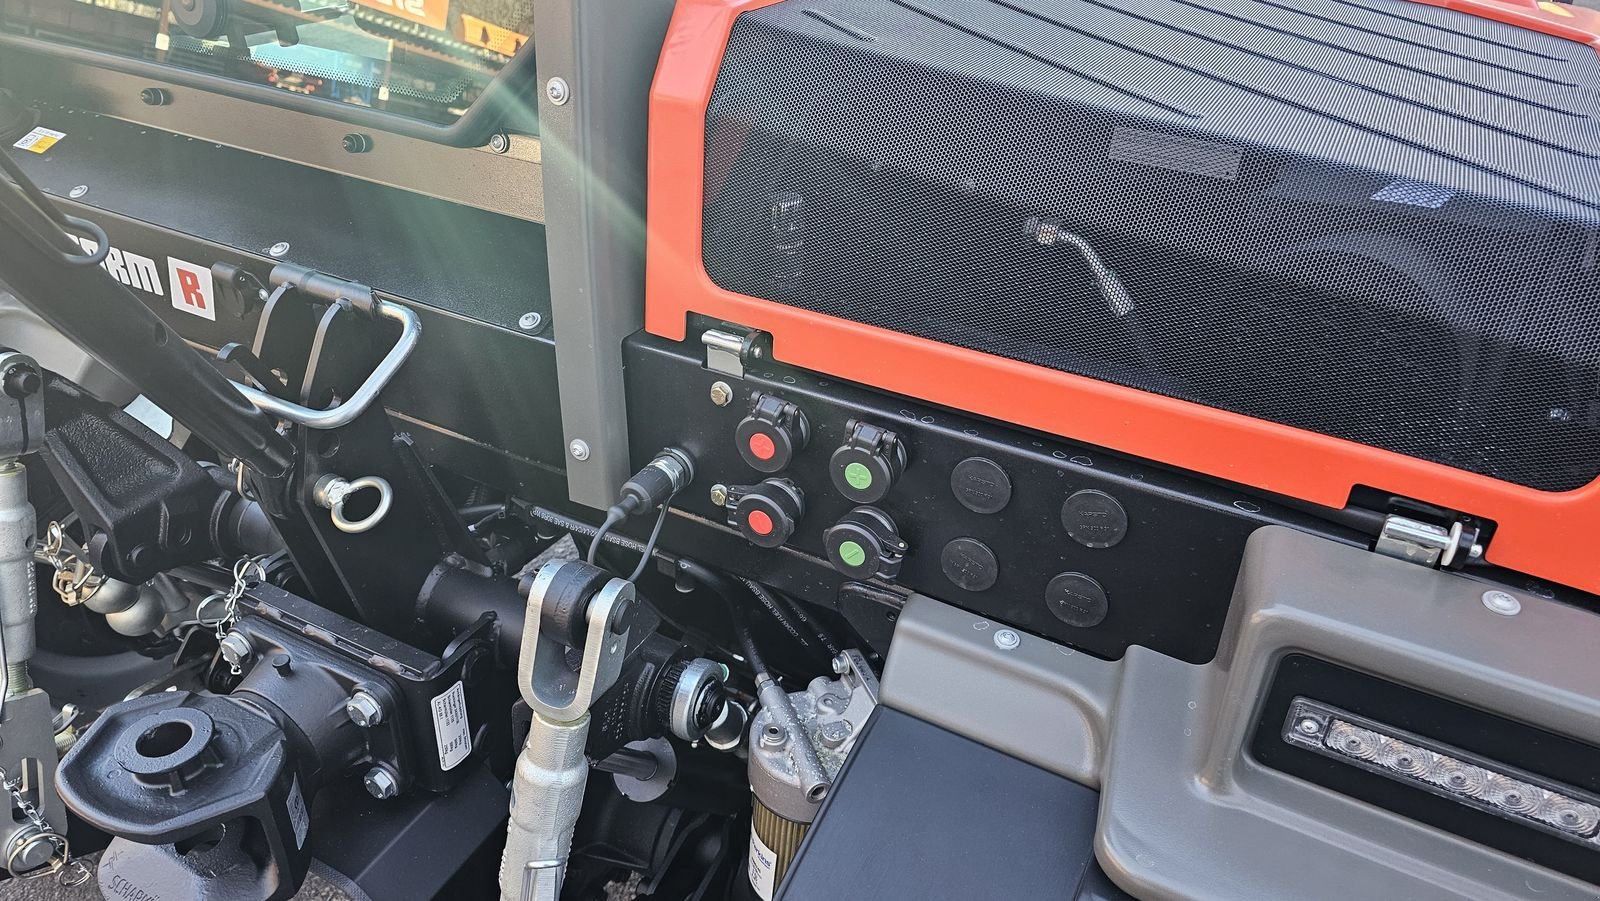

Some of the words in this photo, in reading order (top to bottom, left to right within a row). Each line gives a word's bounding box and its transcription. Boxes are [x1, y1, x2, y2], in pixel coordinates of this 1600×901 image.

[175, 267, 206, 309] R
[620, 539, 637, 549] HOSE
[759, 593, 773, 609] HOSE
[771, 608, 784, 621] FUEL
[108, 874, 160, 901] SCHARM
